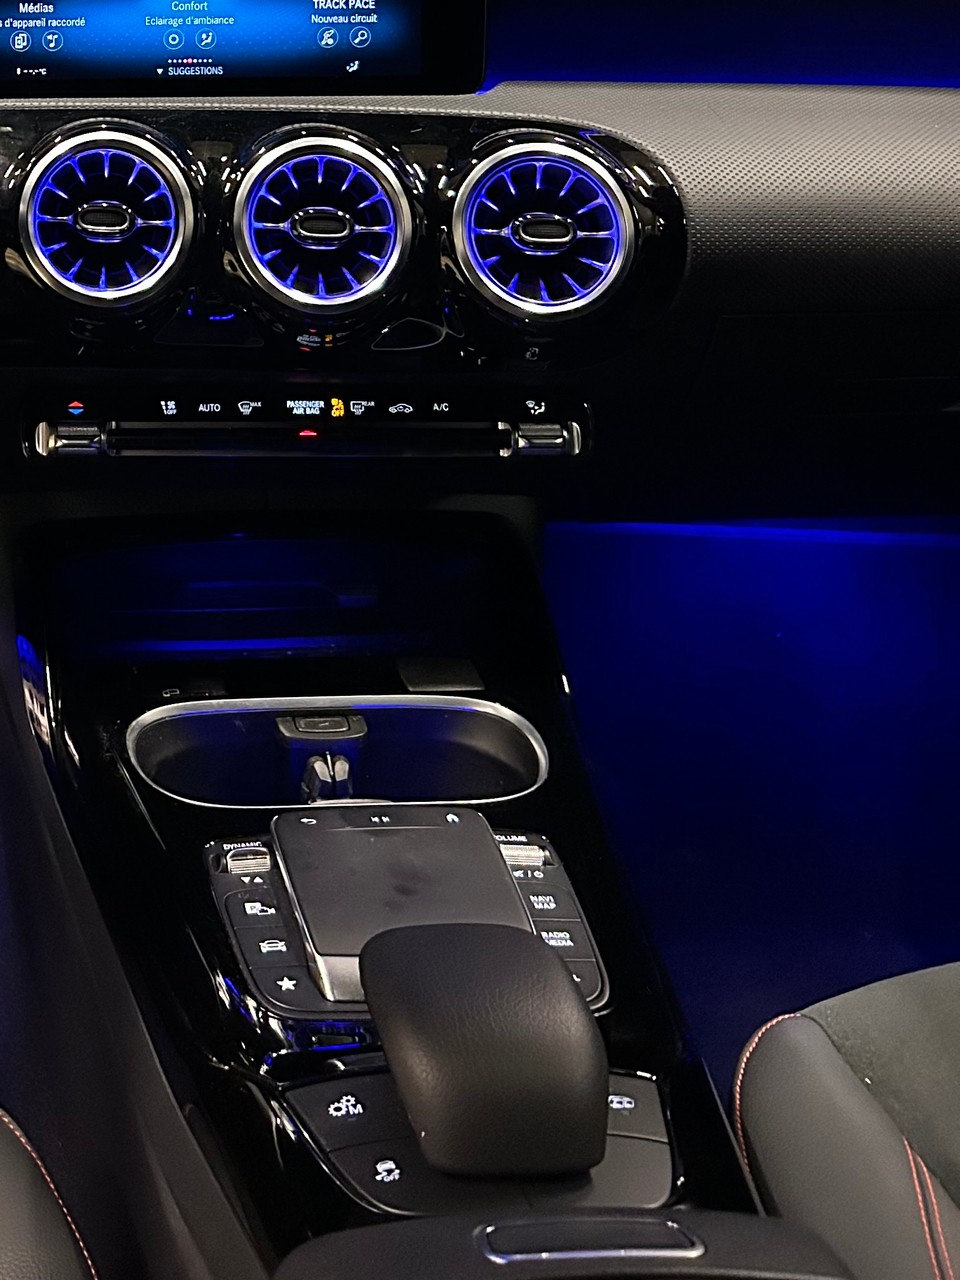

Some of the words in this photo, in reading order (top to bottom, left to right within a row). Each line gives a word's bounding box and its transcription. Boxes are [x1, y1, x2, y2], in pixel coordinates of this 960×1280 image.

[19, 2, 54, 14] Médias
[171, 1, 208, 12] Confort
[5, 18, 46, 29] d'appareil
[48, 17, 86, 28] raccordé
[145, 16, 184, 27] Eclairage
[185, 16, 235, 26] d'ambiance
[311, 14, 348, 24] Nouveau
[350, 13, 378, 23] circuit
[168, 66, 224, 76] SUGGESTIONS
[198, 403, 221, 412] AUTO
[286, 400, 325, 408] PASSENGER
[433, 403, 449, 411] A/C
[292, 407, 305, 415] AIR
[305, 407, 320, 415] BAG
[331, 409, 344, 417] OFF
[223, 841, 263, 850] DYNAMIC
[529, 895, 554, 903] NAVI
[534, 902, 556, 910] MAP
[540, 931, 570, 939] RADIO
[348, 1104, 363, 1115] M
